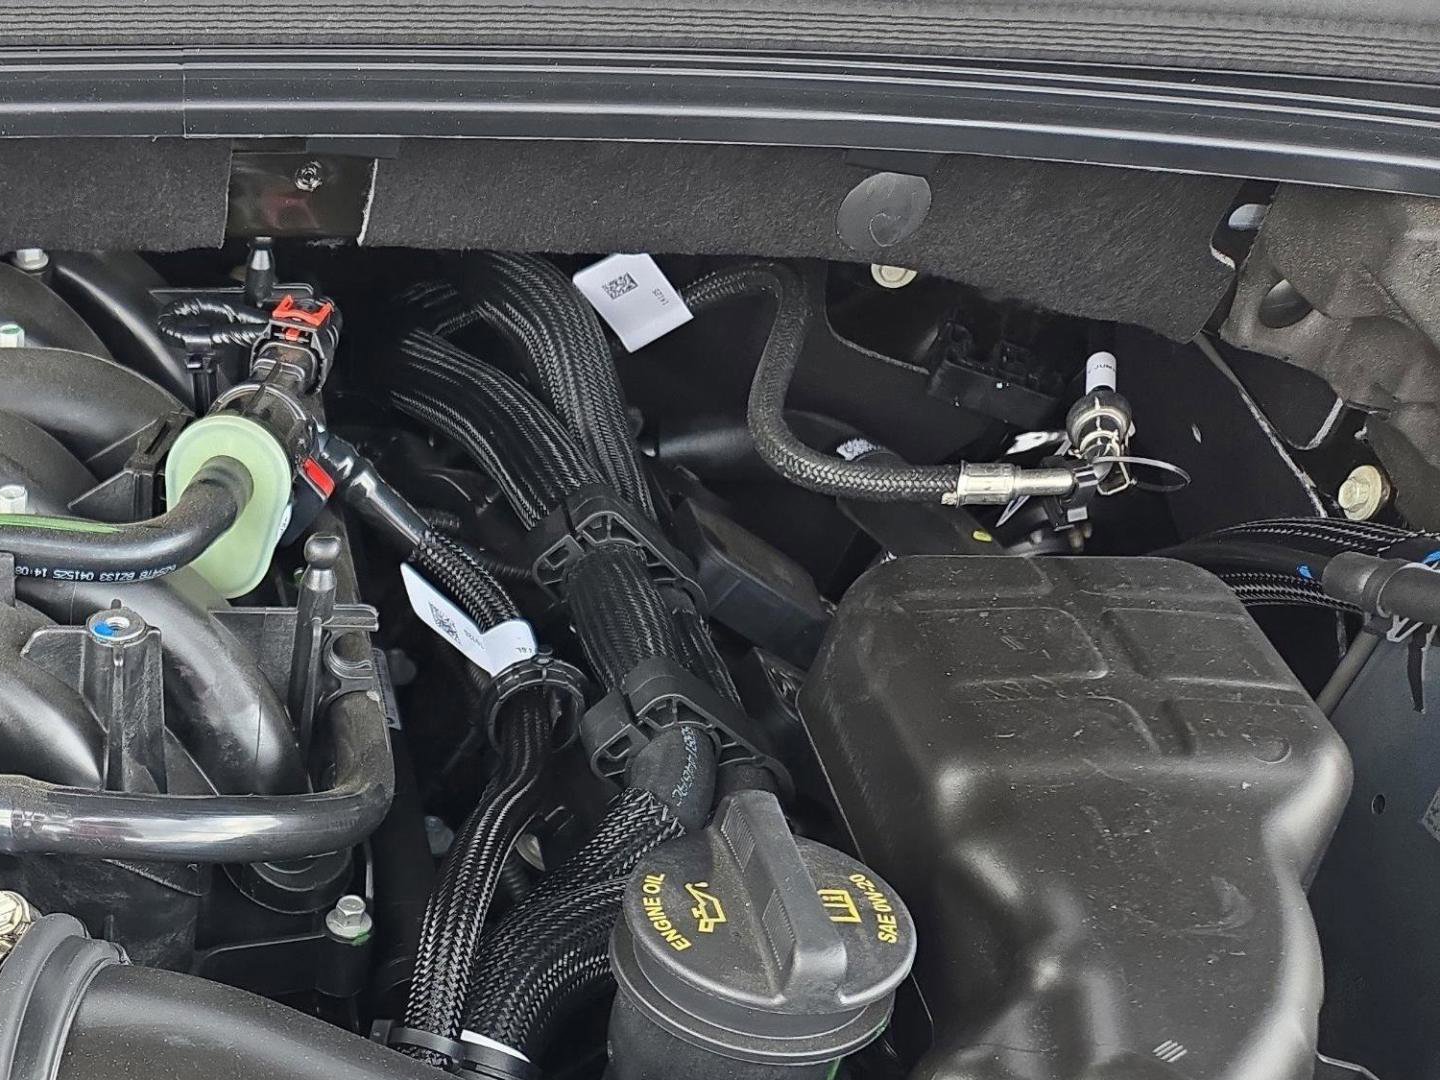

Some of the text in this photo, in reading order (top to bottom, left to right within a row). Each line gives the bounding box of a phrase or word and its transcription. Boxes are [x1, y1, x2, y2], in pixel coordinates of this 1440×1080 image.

[52, 569, 93, 580] 041525
[643, 873, 691, 951] ENGINE OIL
[850, 874, 898, 944] SAE 0W-20
